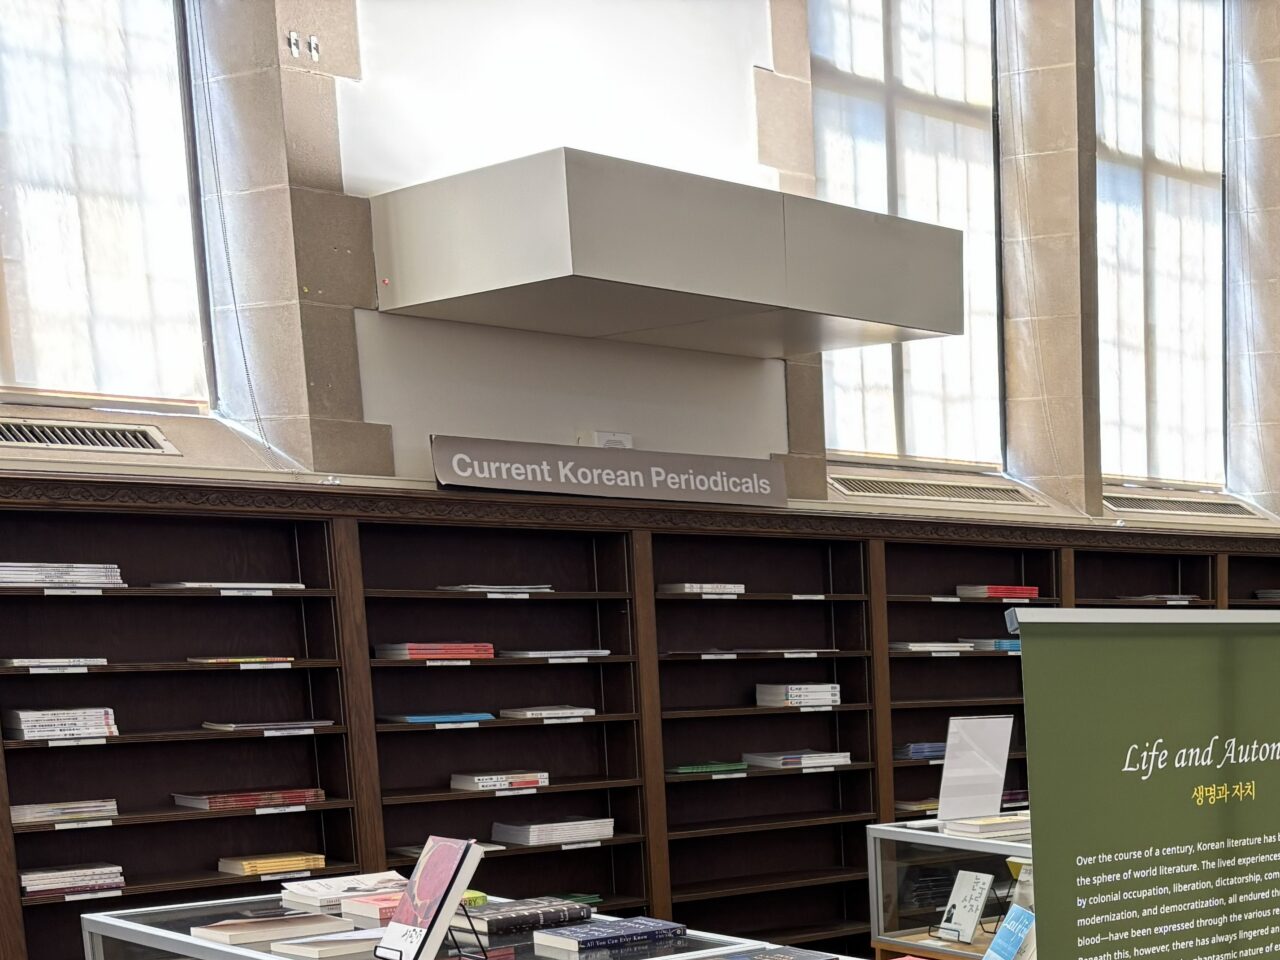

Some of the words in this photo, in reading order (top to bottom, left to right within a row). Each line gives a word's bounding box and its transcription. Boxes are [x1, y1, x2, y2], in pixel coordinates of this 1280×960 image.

[452, 453, 552, 482] Current
[558, 460, 644, 487] Korean
[651, 468, 771, 493] Periodicals
[1122, 739, 1168, 780] Life
[1175, 736, 1219, 768] and
[1192, 784, 1229, 805] 생명과
[1232, 781, 1255, 801] 자치
[1076, 856, 1097, 866] Over
[1098, 853, 1113, 863] the
[1114, 850, 1142, 861] course
[1144, 847, 1153, 857] of
[1154, 848, 1160, 856] a
[1162, 845, 1195, 856] century,
[1197, 841, 1225, 851] Korean
[1226, 837, 1262, 848] literature
[1263, 834, 1277, 843] has
